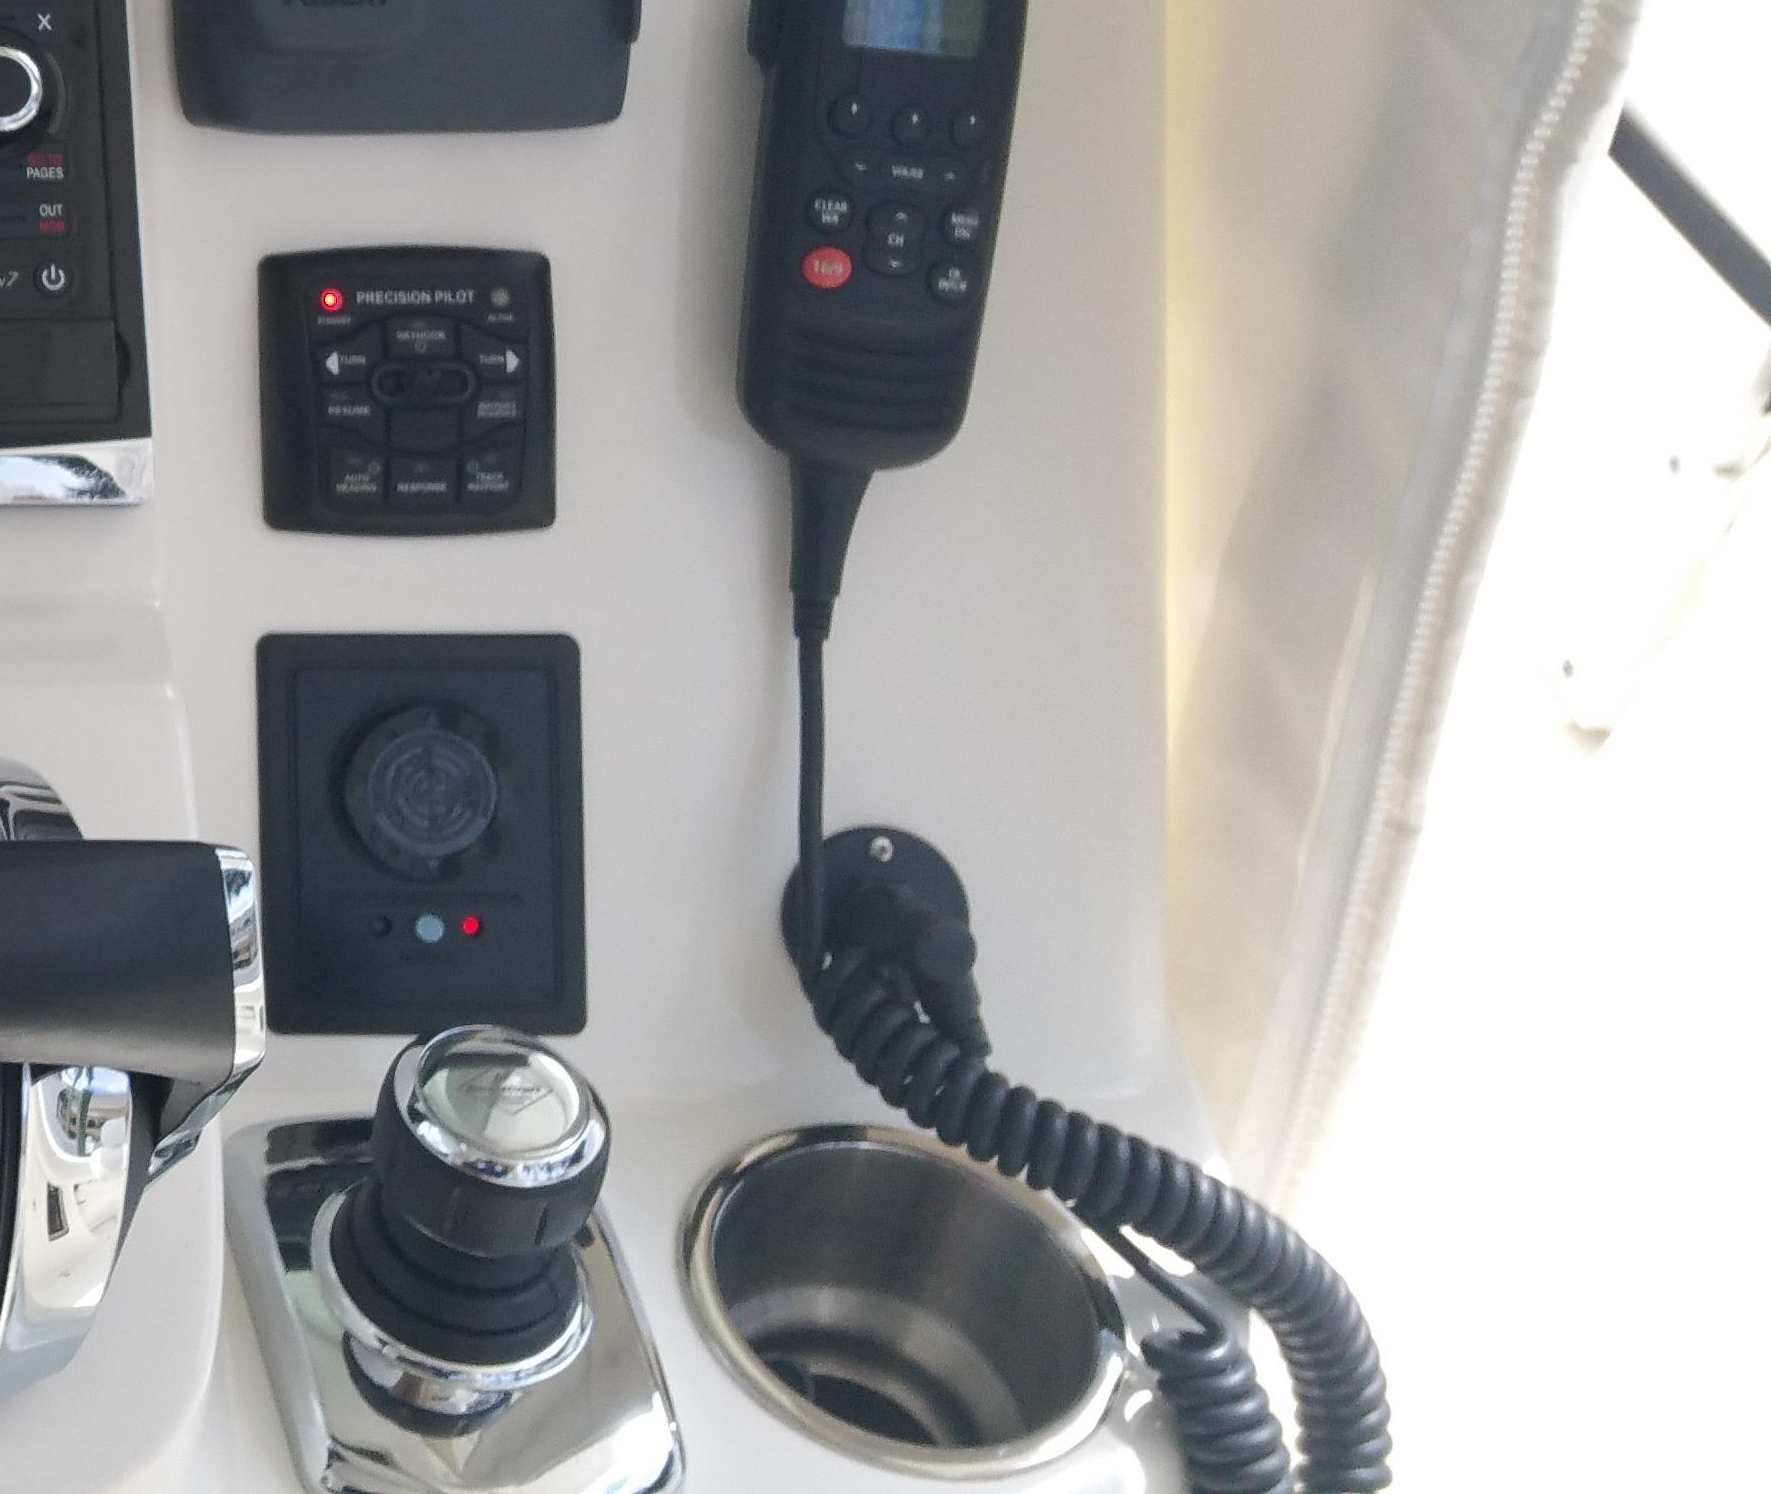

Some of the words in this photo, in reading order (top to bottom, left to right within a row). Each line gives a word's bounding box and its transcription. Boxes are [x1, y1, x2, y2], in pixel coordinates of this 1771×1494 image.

[26, 166, 64, 179] PAGES
[39, 204, 63, 218] OUT
[356, 290, 431, 304] PRECISION
[433, 290, 475, 303] PILOT
